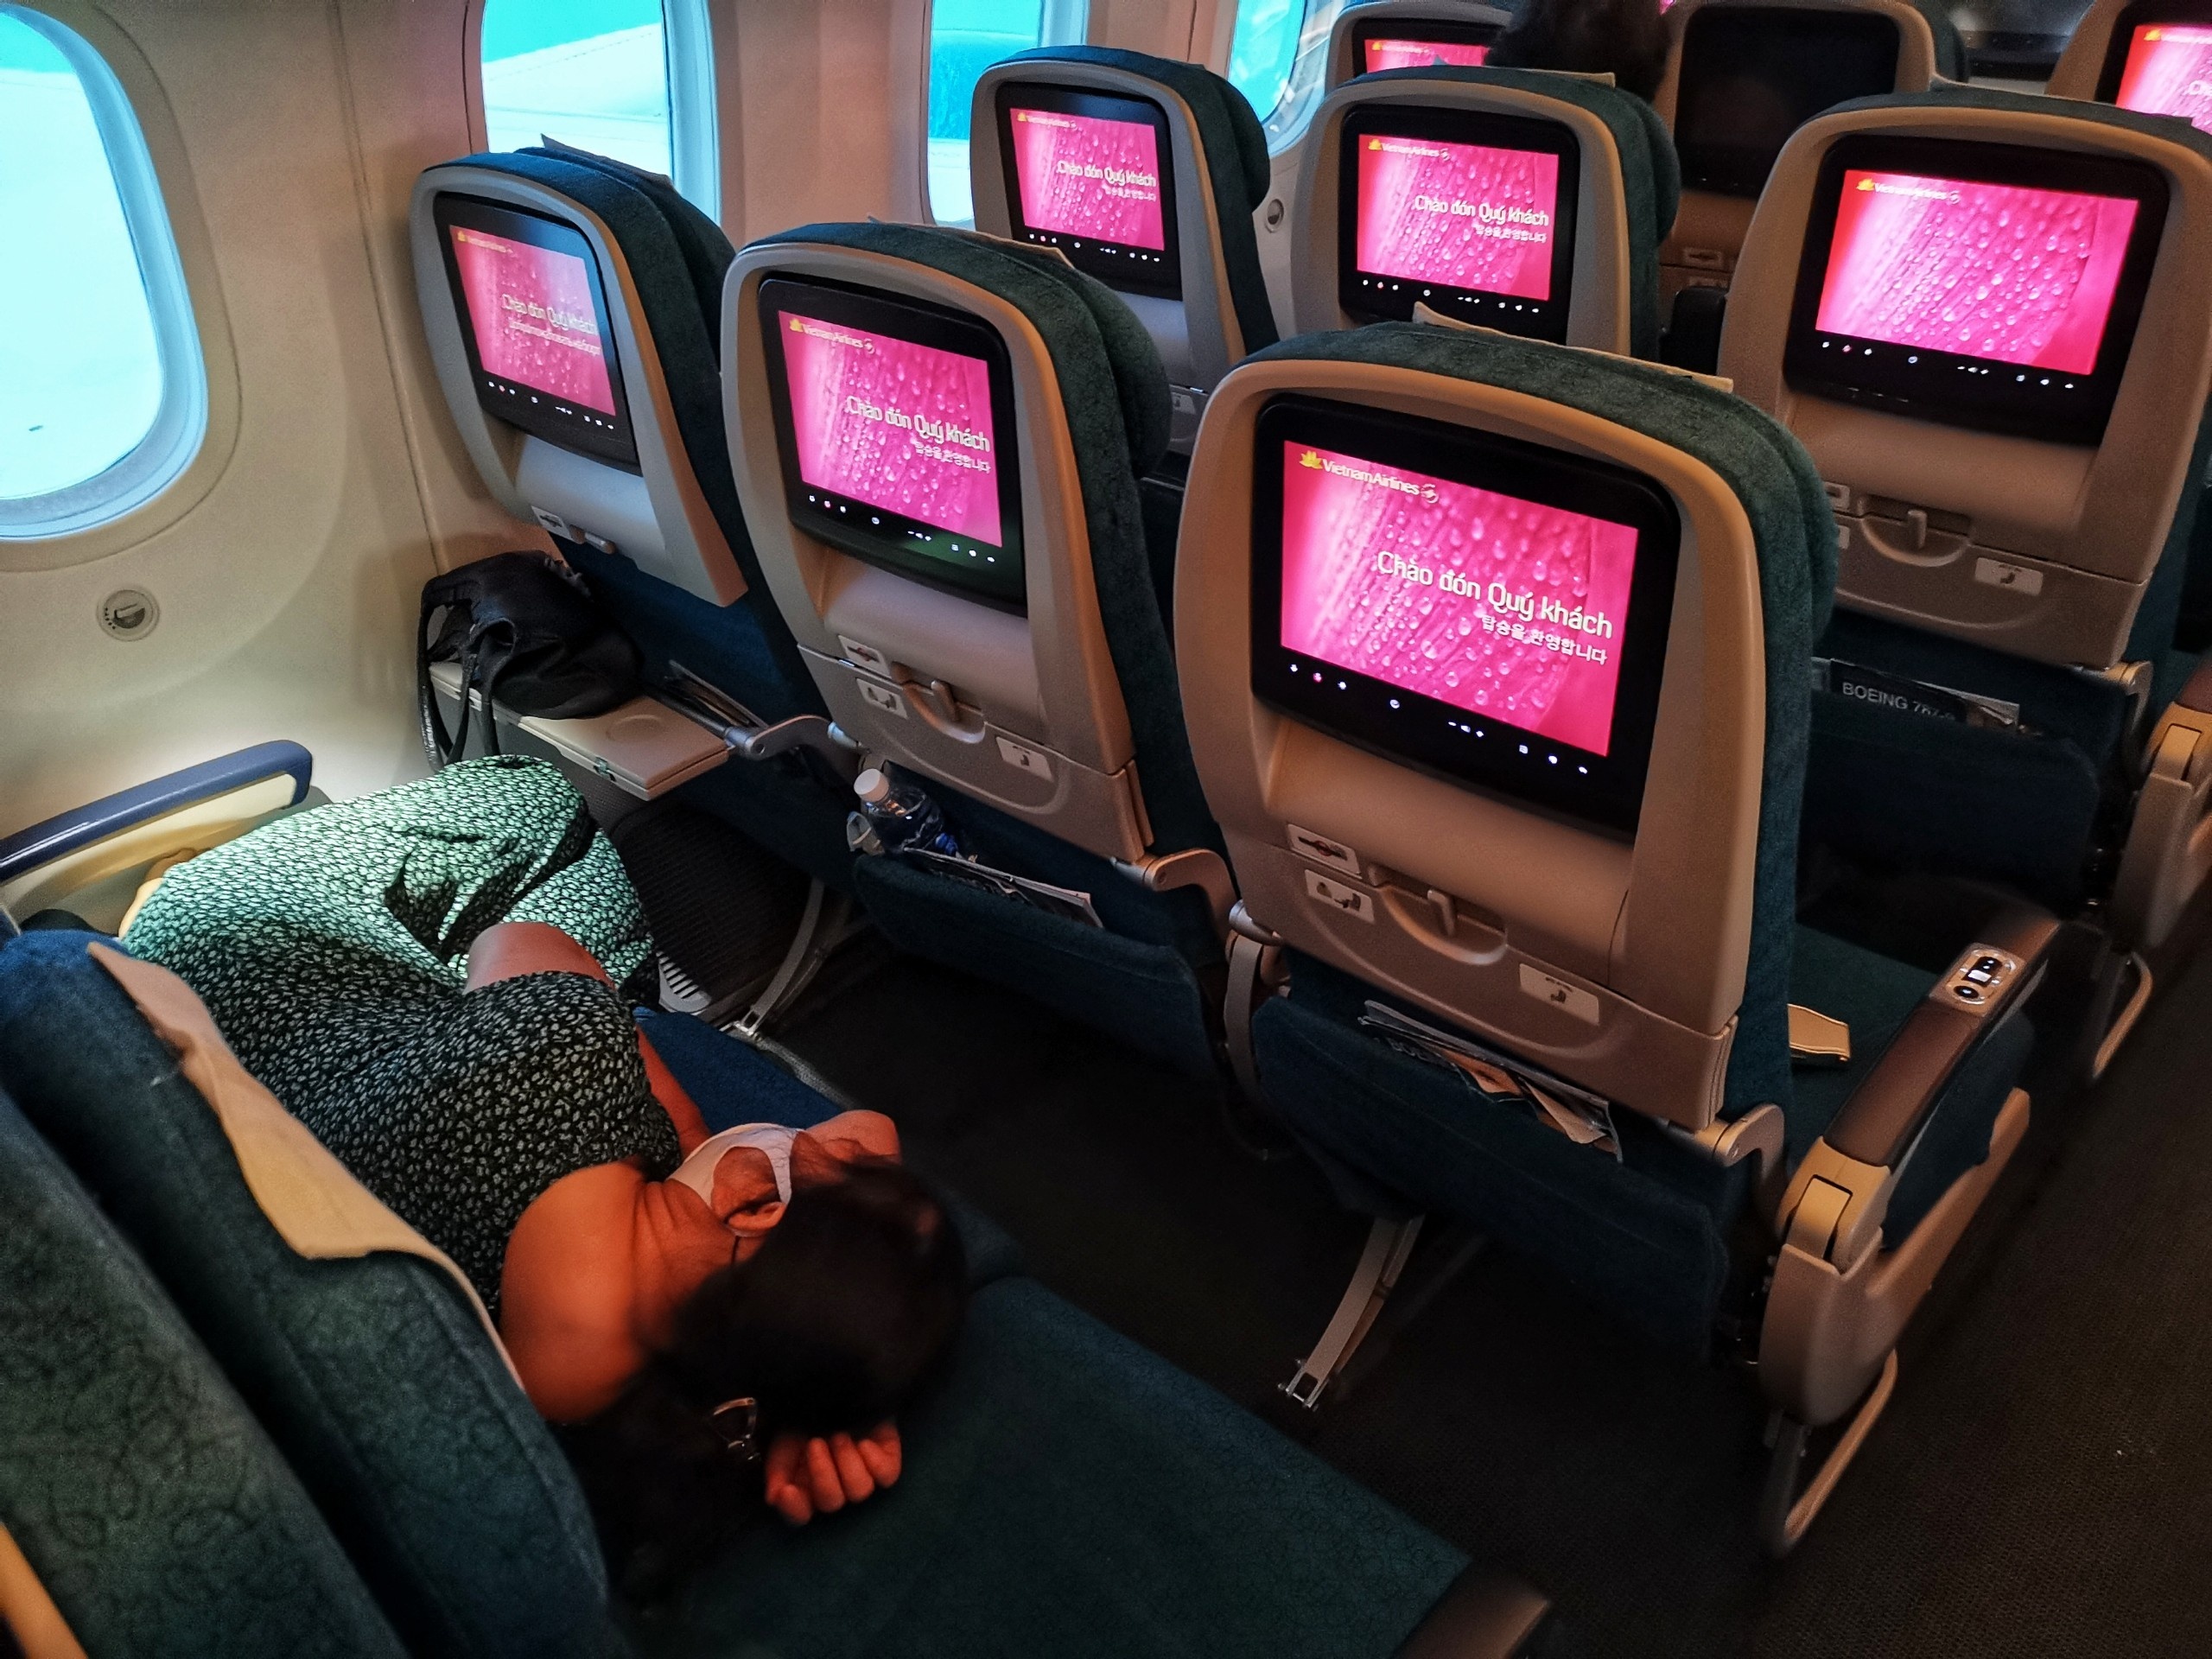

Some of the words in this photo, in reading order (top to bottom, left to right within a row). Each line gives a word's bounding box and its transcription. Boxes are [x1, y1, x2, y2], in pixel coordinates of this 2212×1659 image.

[1377, 551, 1433, 586] Chào
[1439, 569, 1481, 600] đón
[1488, 582, 1535, 622] Quý
[1541, 596, 1613, 639] khách
[1842, 682, 1908, 709] BOEING
